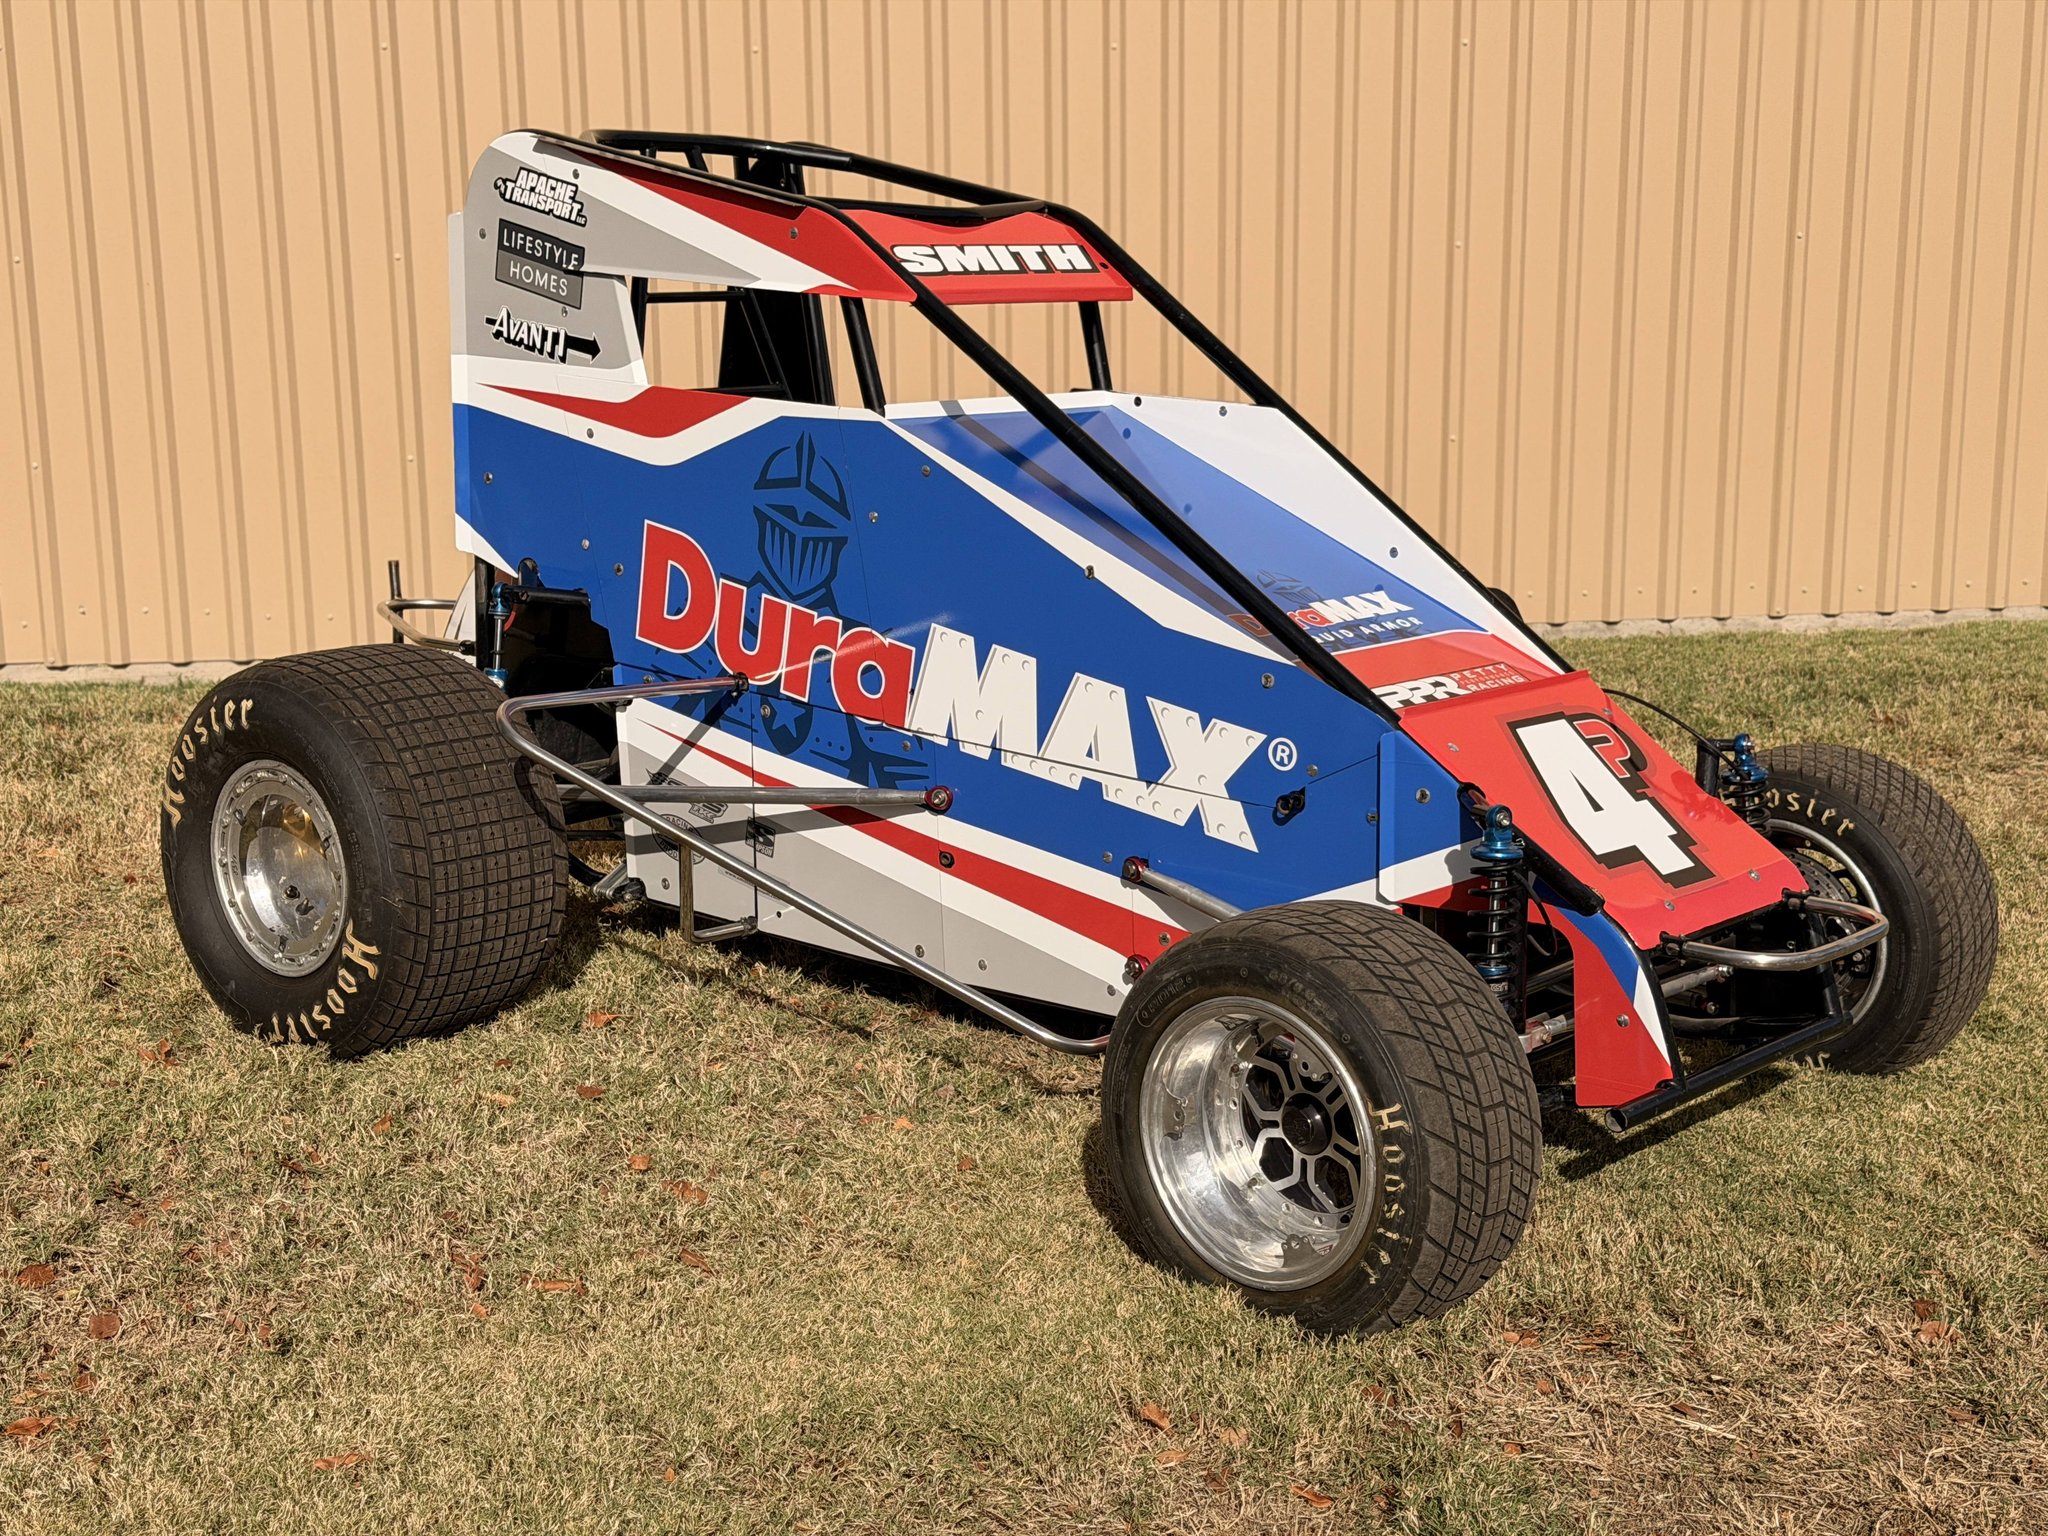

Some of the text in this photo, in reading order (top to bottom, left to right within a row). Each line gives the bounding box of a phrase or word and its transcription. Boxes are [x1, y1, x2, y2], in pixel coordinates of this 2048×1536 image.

[504, 181, 582, 221] TRANSPORT
[516, 169, 577, 203] APACHE
[503, 227, 579, 270] LIFESTYLE
[892, 244, 1093, 274] SMITH
[509, 260, 568, 296] HOMES
[493, 307, 567, 358] AVANTI
[1226, 590, 1415, 637] DraMAX
[1358, 616, 1424, 636] ARMOR
[1370, 675, 1473, 710] PPR
[1449, 663, 1508, 681] PETTY
[1466, 674, 1526, 692] RACING
[163, 695, 254, 831] Hoosier
[1717, 785, 1856, 836] osier
